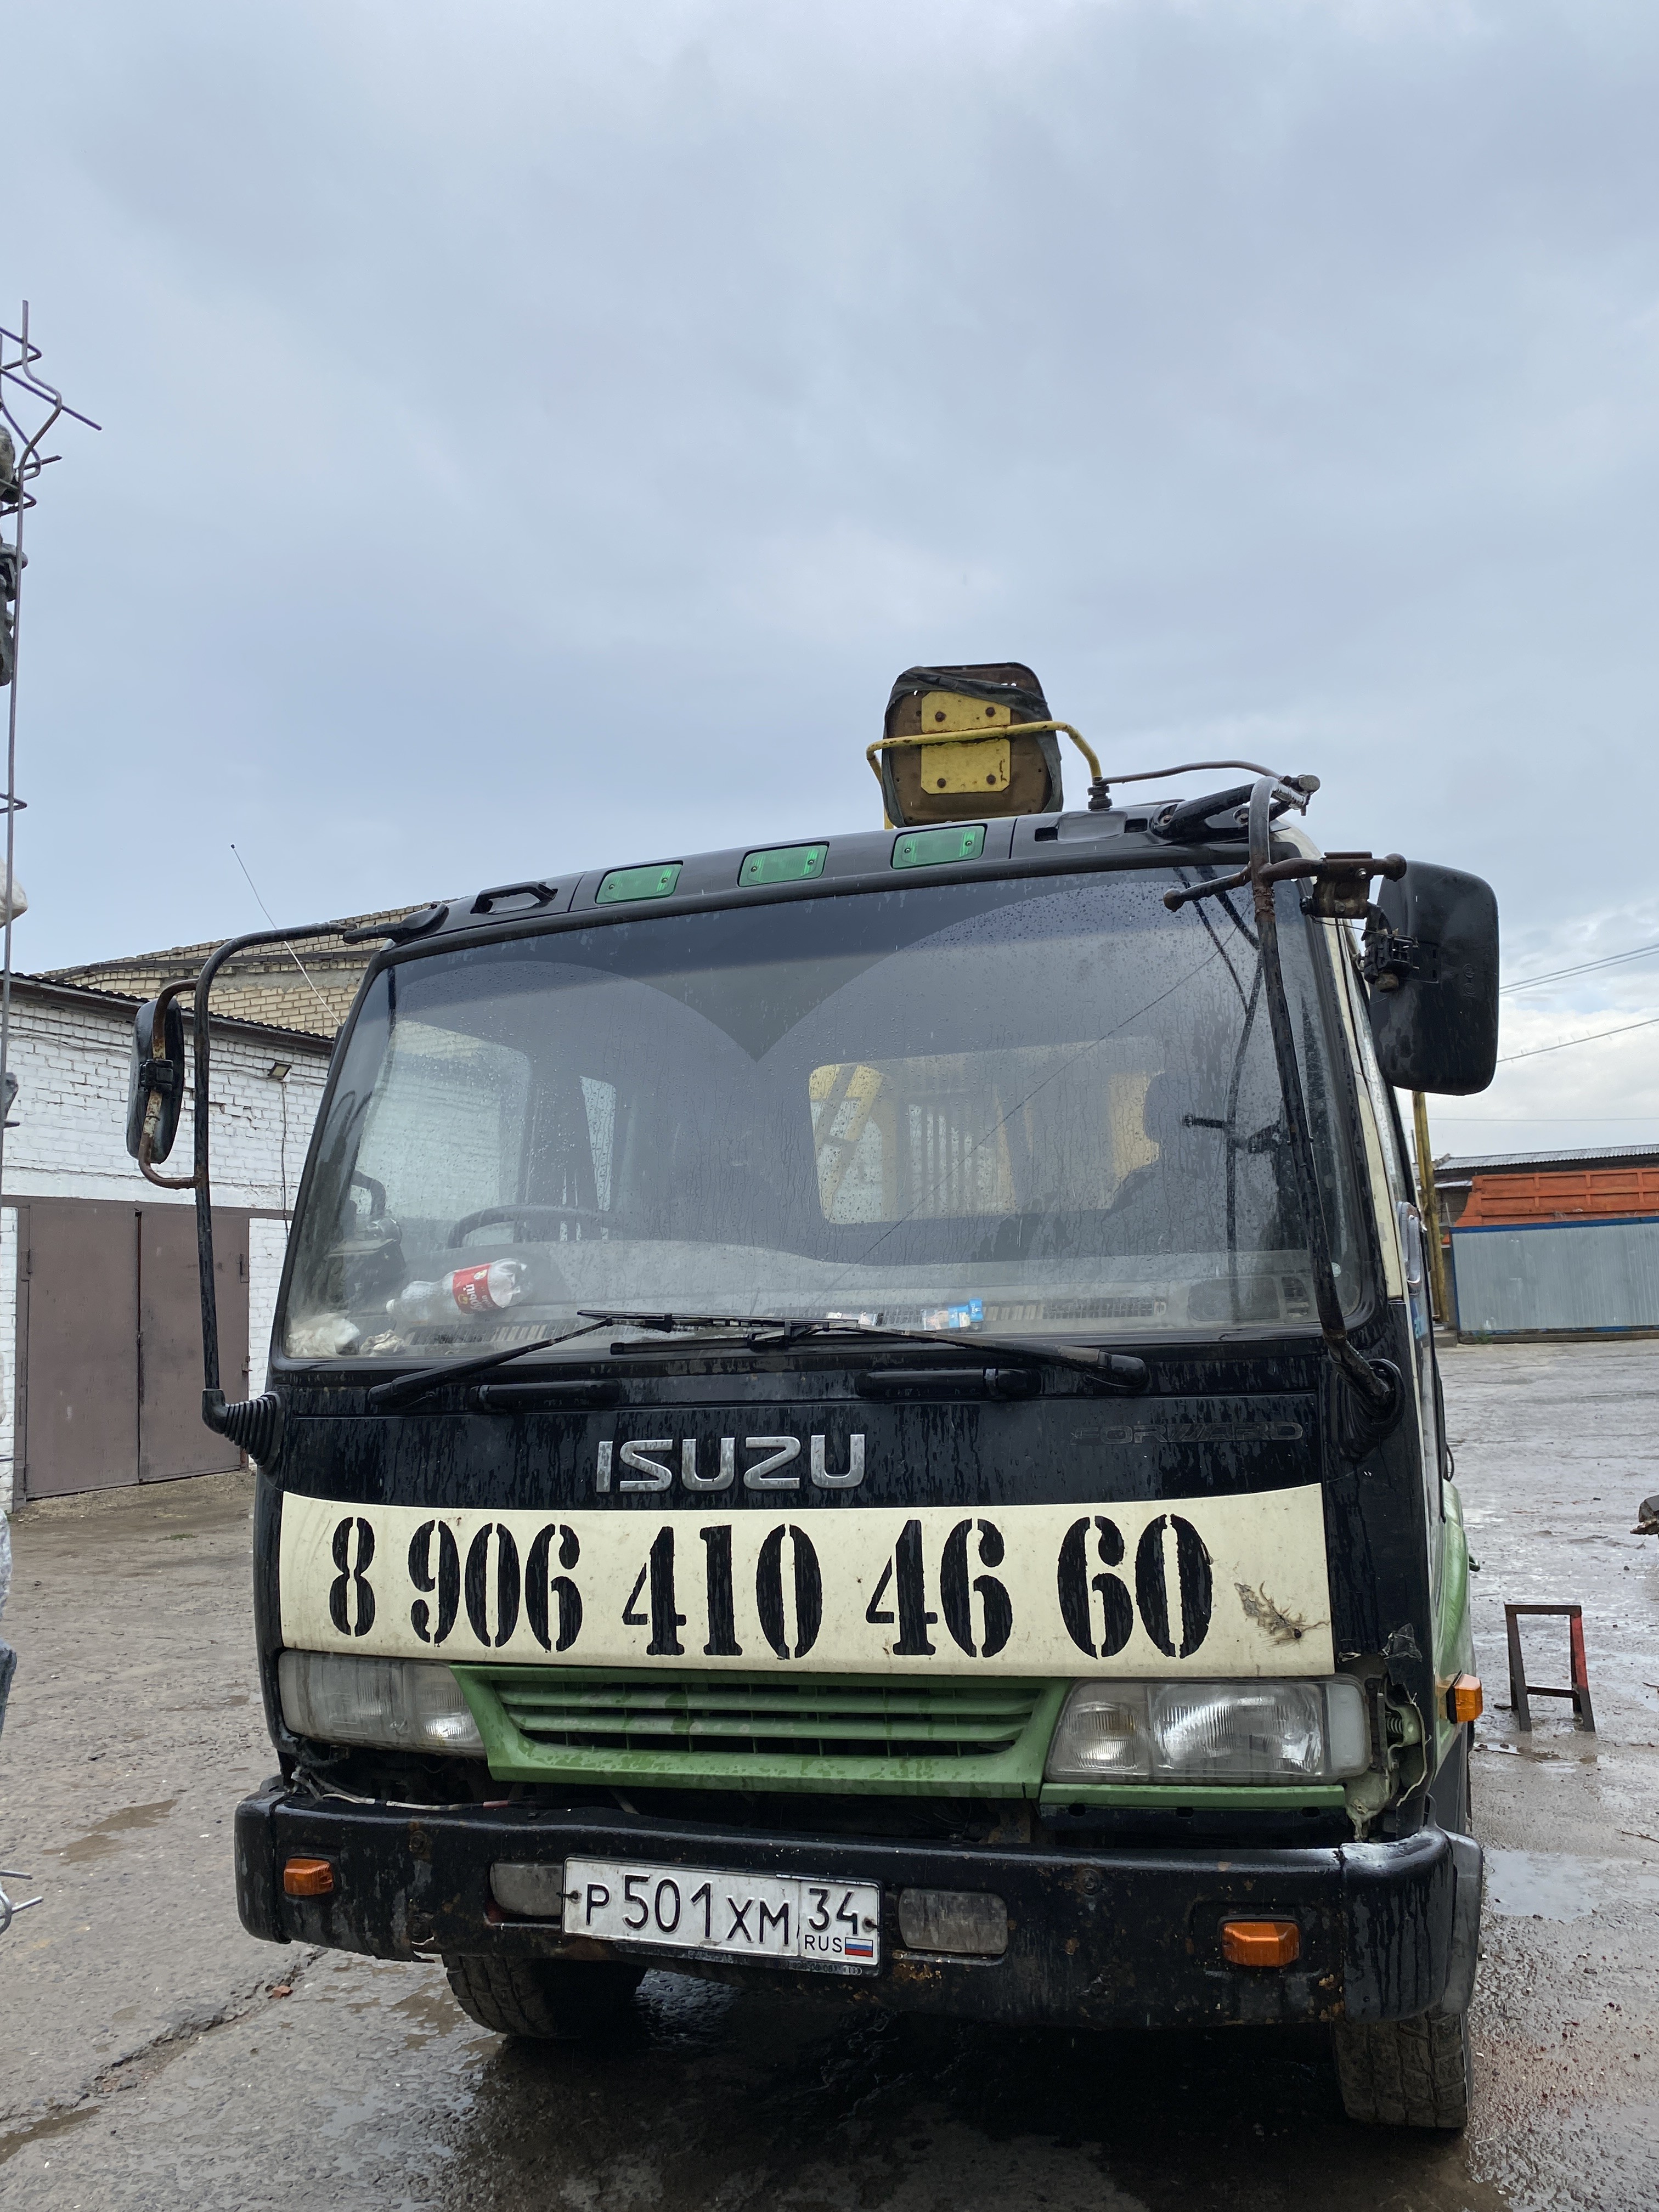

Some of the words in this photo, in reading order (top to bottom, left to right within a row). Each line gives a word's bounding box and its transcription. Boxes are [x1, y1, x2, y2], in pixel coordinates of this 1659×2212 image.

[463, 1284, 486, 1312] обрый
[1071, 1421, 1304, 1446] FORWARD
[595, 1434, 866, 1493] ISUZU
[330, 1516, 375, 1638] 8
[408, 1519, 583, 1652] 906
[621, 1523, 823, 1660] 410
[865, 1517, 1014, 1658] 46
[1057, 1513, 1213, 1659] 60
[806, 1887, 860, 1936] 34
[804, 1934, 842, 1953] RUS
